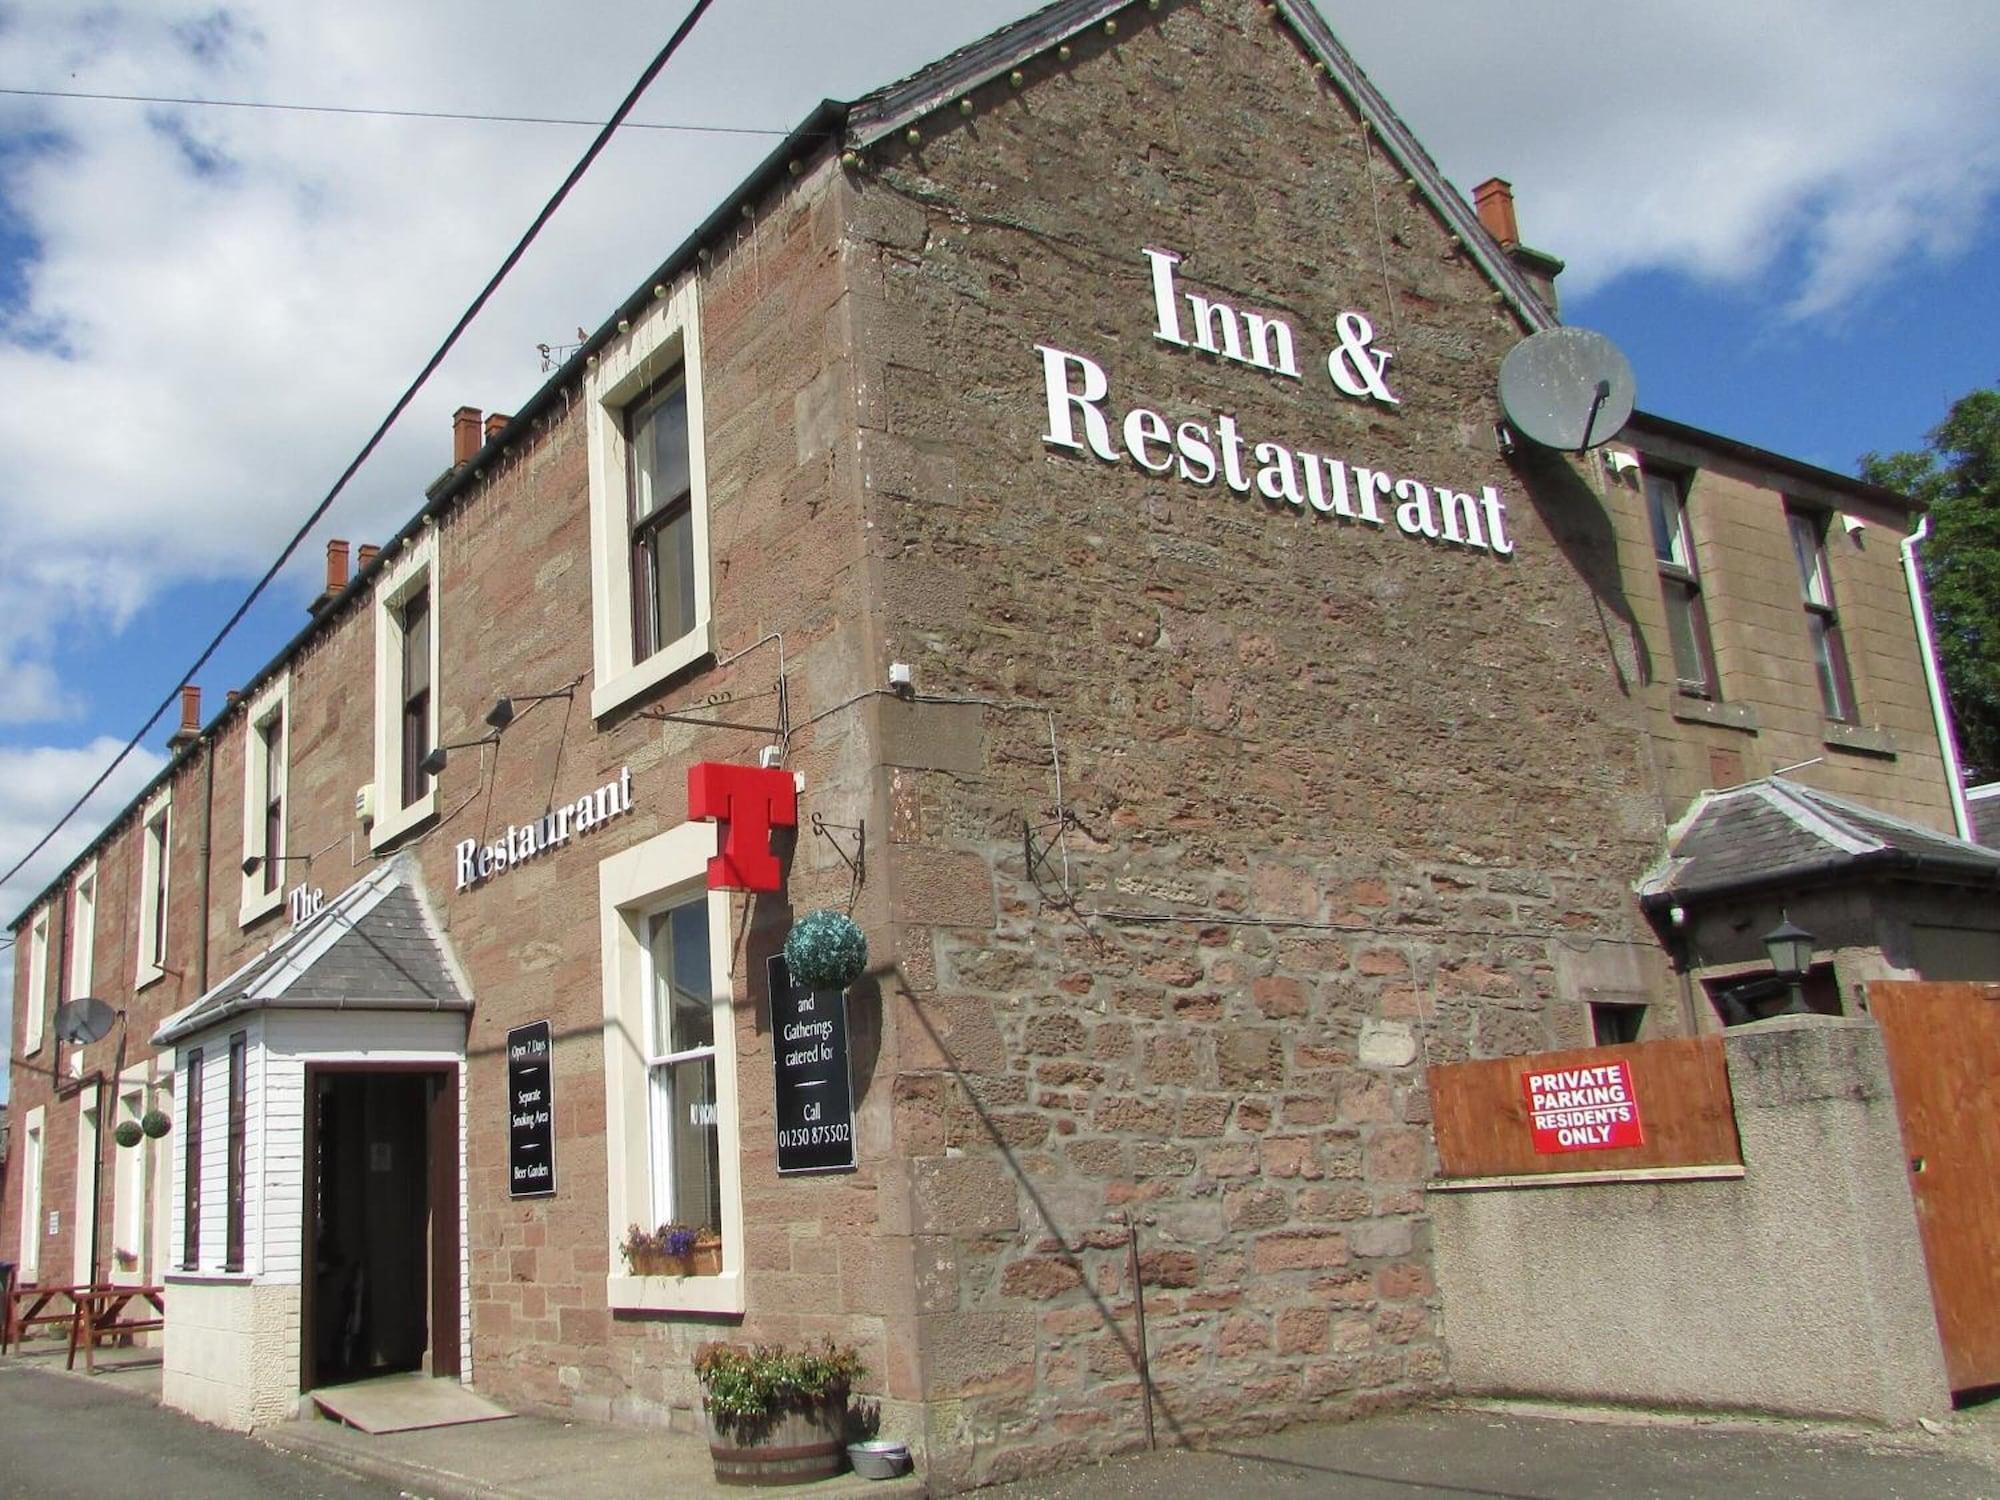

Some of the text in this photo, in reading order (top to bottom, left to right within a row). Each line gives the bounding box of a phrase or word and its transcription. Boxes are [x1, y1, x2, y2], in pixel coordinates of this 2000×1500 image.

[1142, 248, 1399, 404] Inn &
[1033, 344, 1513, 554] Restaurant
[289, 766, 633, 924] The Restaurant
[798, 992, 815, 1012] and
[784, 1020, 833, 1040] Gatherings
[512, 1046, 526, 1061] Open
[532, 1040, 546, 1056] Days
[785, 1042, 834, 1066] catered for
[1529, 1065, 1621, 1092] PRIVATE
[518, 1089, 541, 1107] Separate
[1533, 1085, 1625, 1110] PARKING
[513, 1110, 548, 1129] Smoking Area
[804, 1102, 820, 1121] Call
[1535, 1105, 1631, 1130] RESIDENTS
[780, 1123, 849, 1147] 01250 875502
[1558, 1125, 1611, 1146] ONLY
[514, 1162, 548, 1179] Beer Garden
